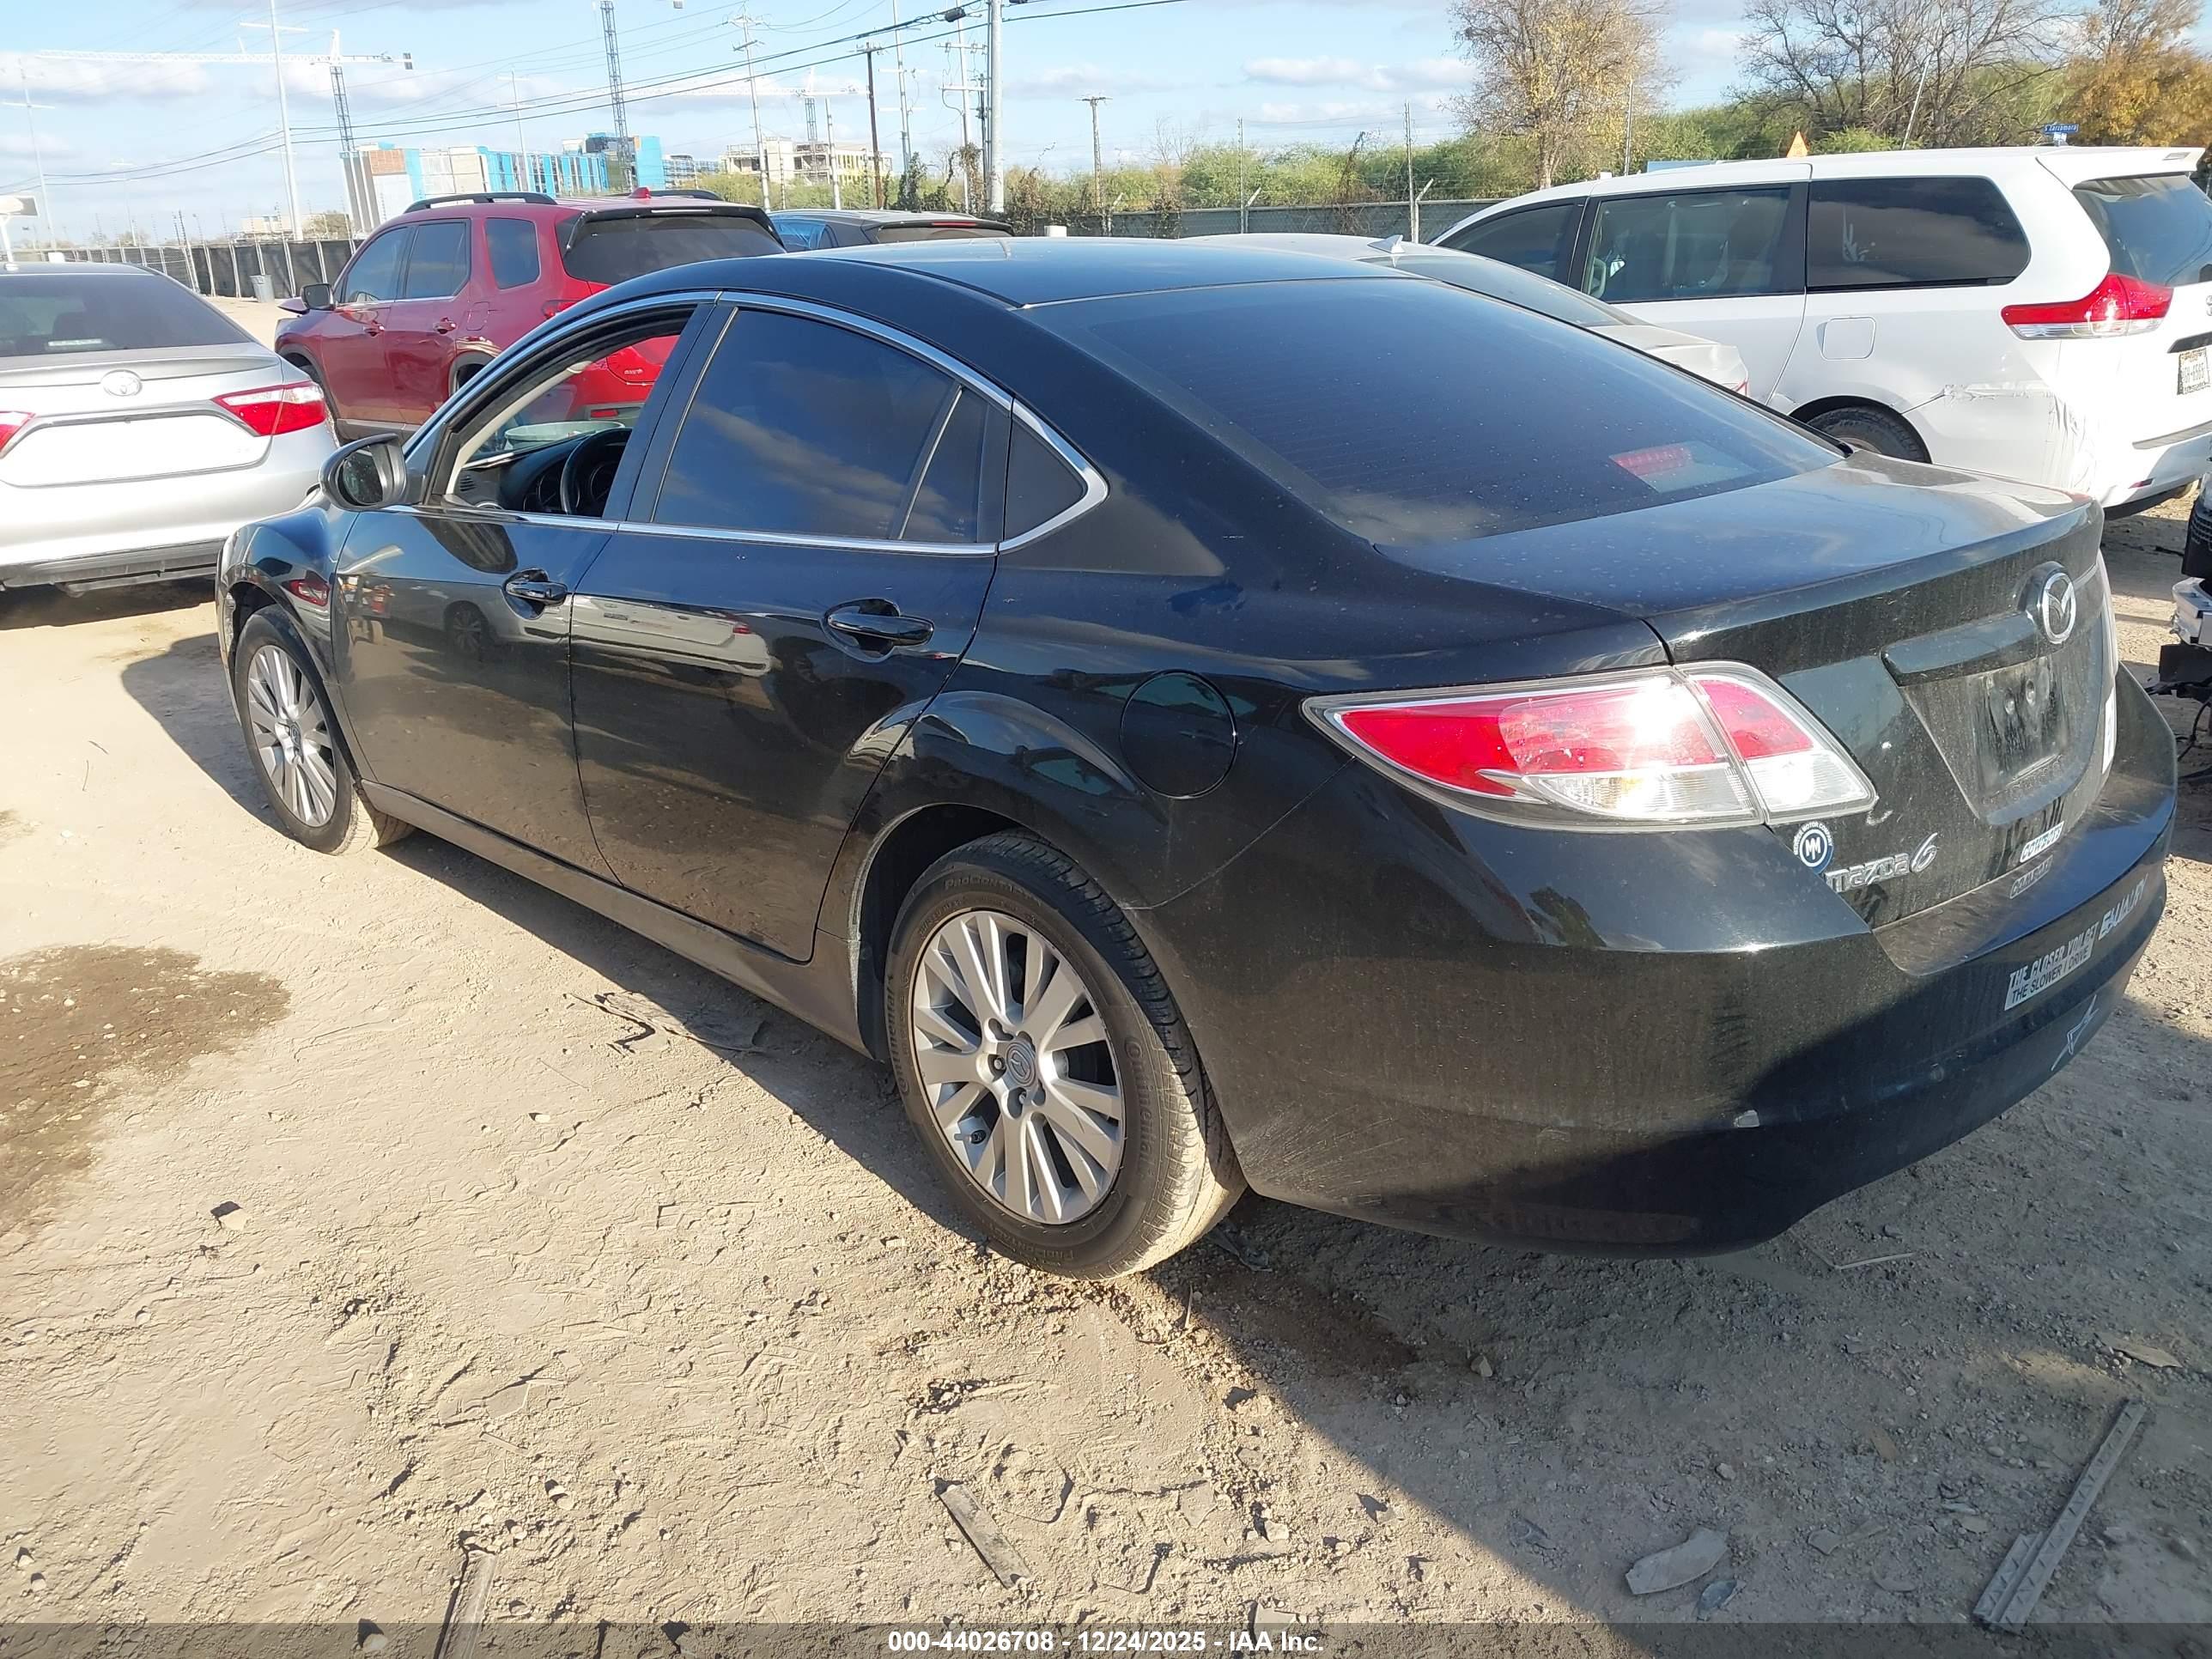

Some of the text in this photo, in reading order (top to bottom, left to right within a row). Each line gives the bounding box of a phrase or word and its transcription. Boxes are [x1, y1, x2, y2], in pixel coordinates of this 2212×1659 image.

[2009, 965, 2028, 988] THE
[2030, 945, 2066, 979] CLOSER
[2012, 983, 2029, 1003] THE
[2030, 967, 2061, 993] SLOWER
